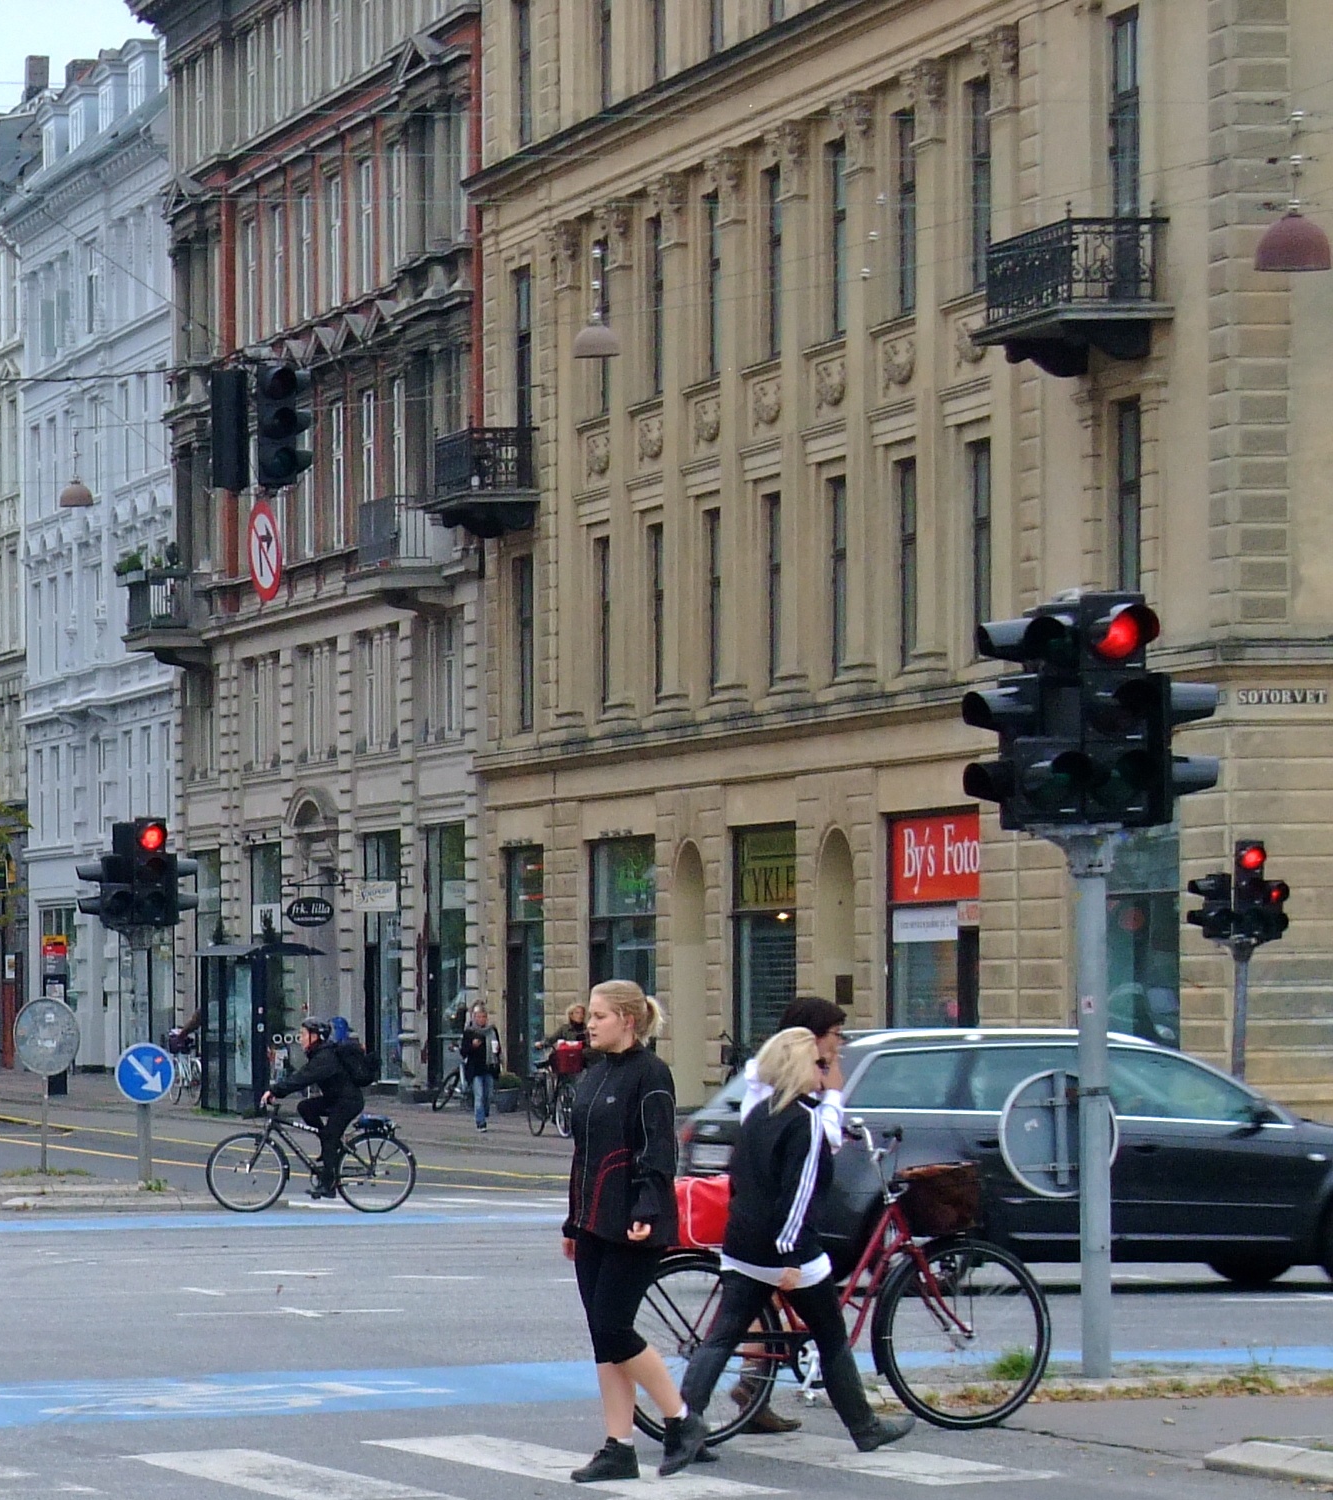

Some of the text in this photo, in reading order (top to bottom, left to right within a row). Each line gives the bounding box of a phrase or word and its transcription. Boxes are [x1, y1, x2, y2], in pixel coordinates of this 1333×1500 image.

[904, 824, 979, 895] By's Foto
[311, 903, 331, 914] lilla
